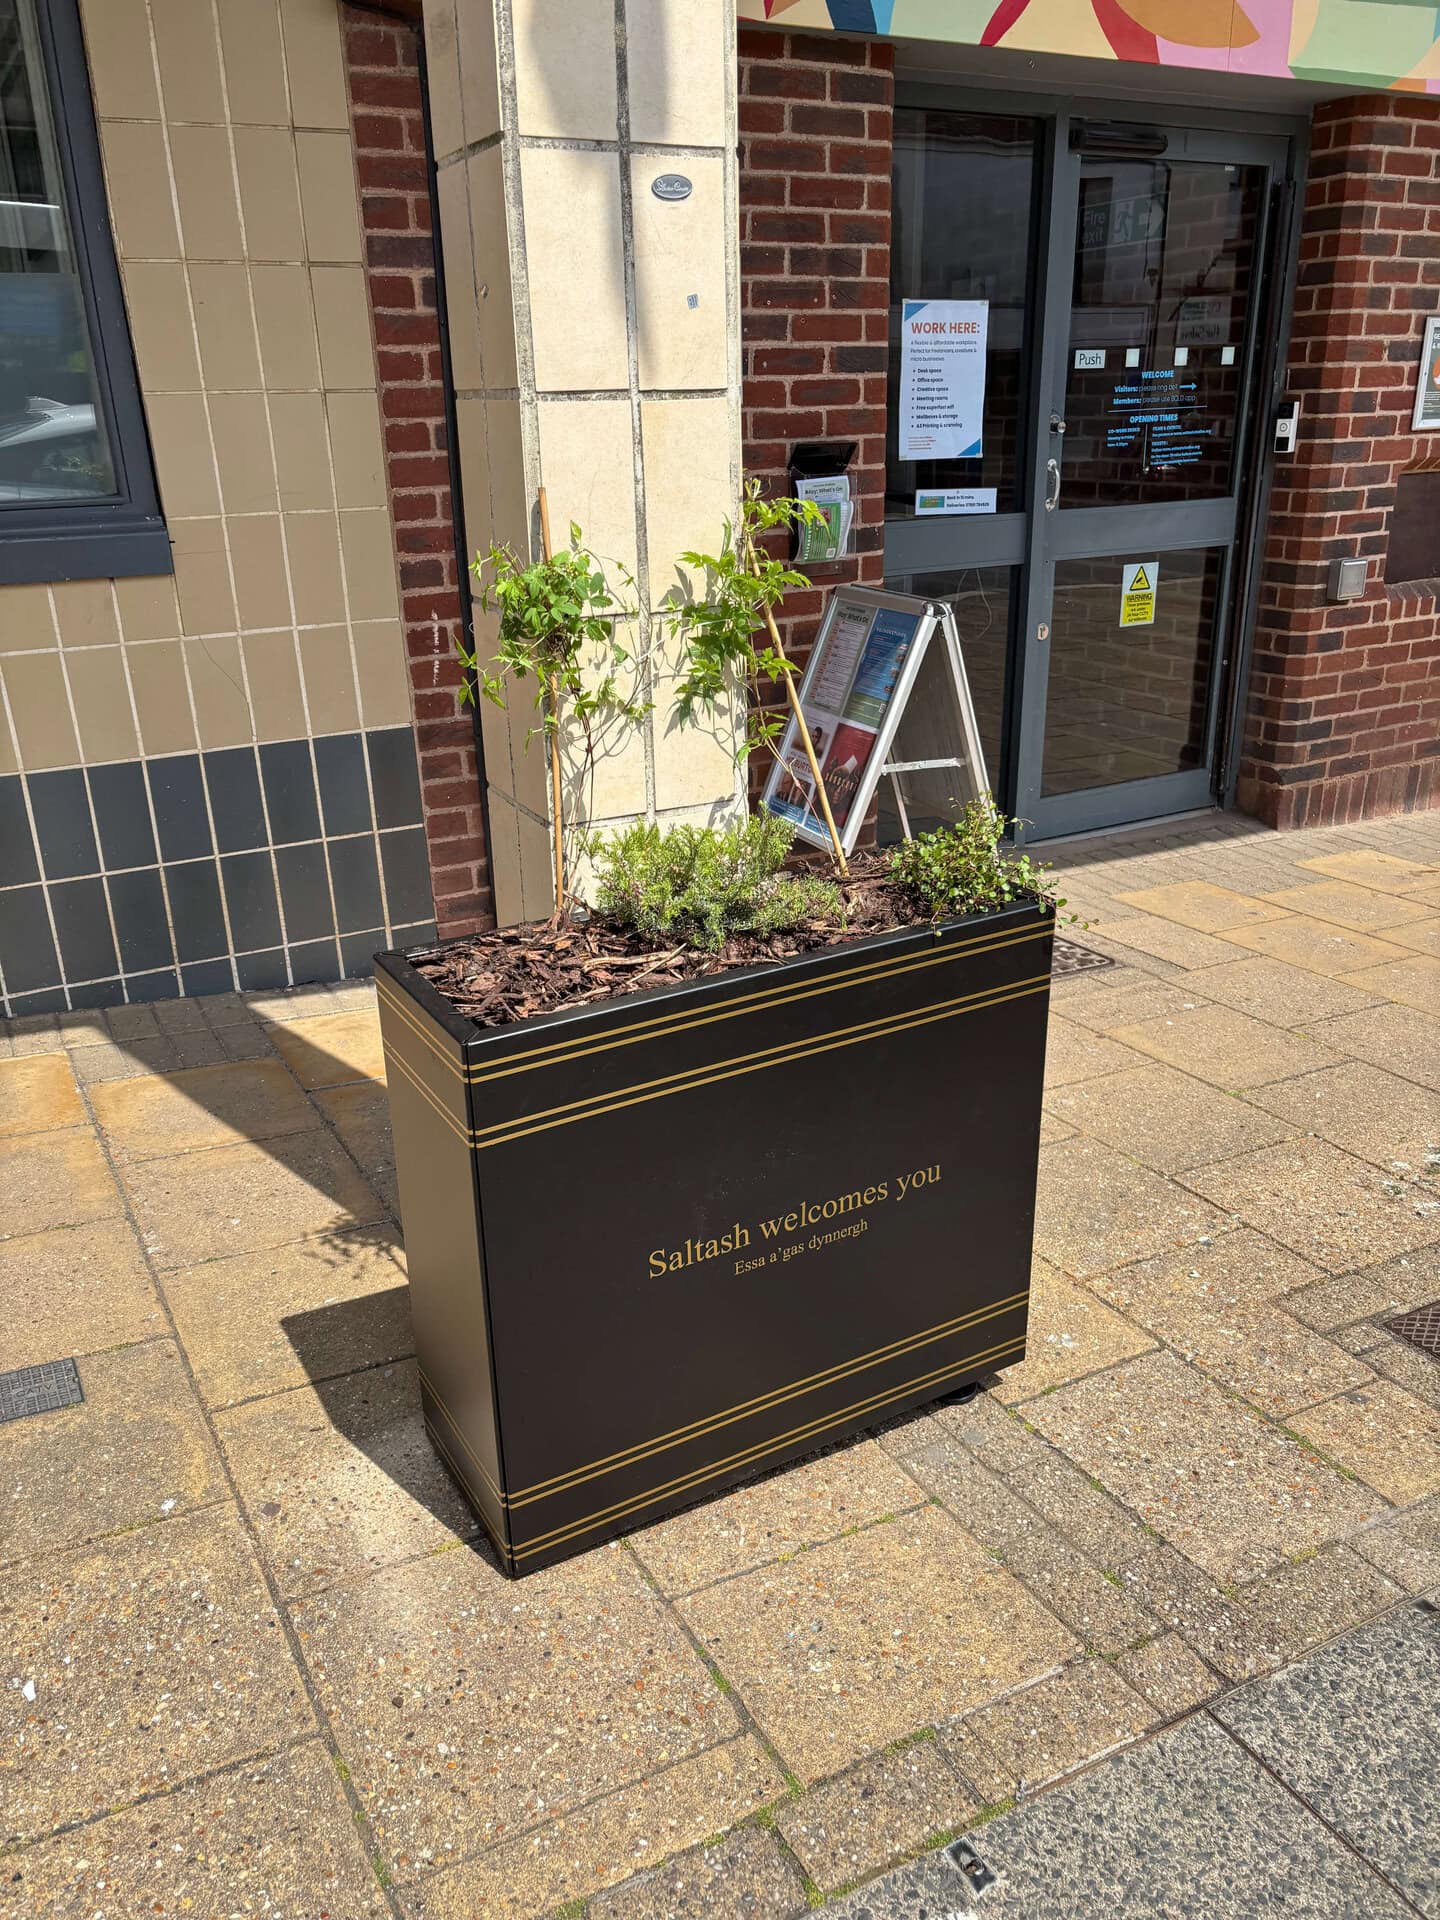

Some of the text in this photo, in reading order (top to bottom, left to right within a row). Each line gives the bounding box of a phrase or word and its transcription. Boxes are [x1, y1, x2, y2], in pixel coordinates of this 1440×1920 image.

[911, 322, 980, 334] WORK HERE:
[1079, 353, 1102, 365] Push
[1142, 370, 1175, 379] WELCOME
[1114, 384, 1138, 393] Visitors:
[1113, 397, 1142, 405] Members:
[1129, 413, 1178, 423] OPENING TIMES
[1127, 593, 1152, 601] WARNING
[648, 1164, 942, 1279] Saltash welcomes you
[734, 1256, 767, 1276] Essa
[808, 1219, 868, 1251] dynnergh
